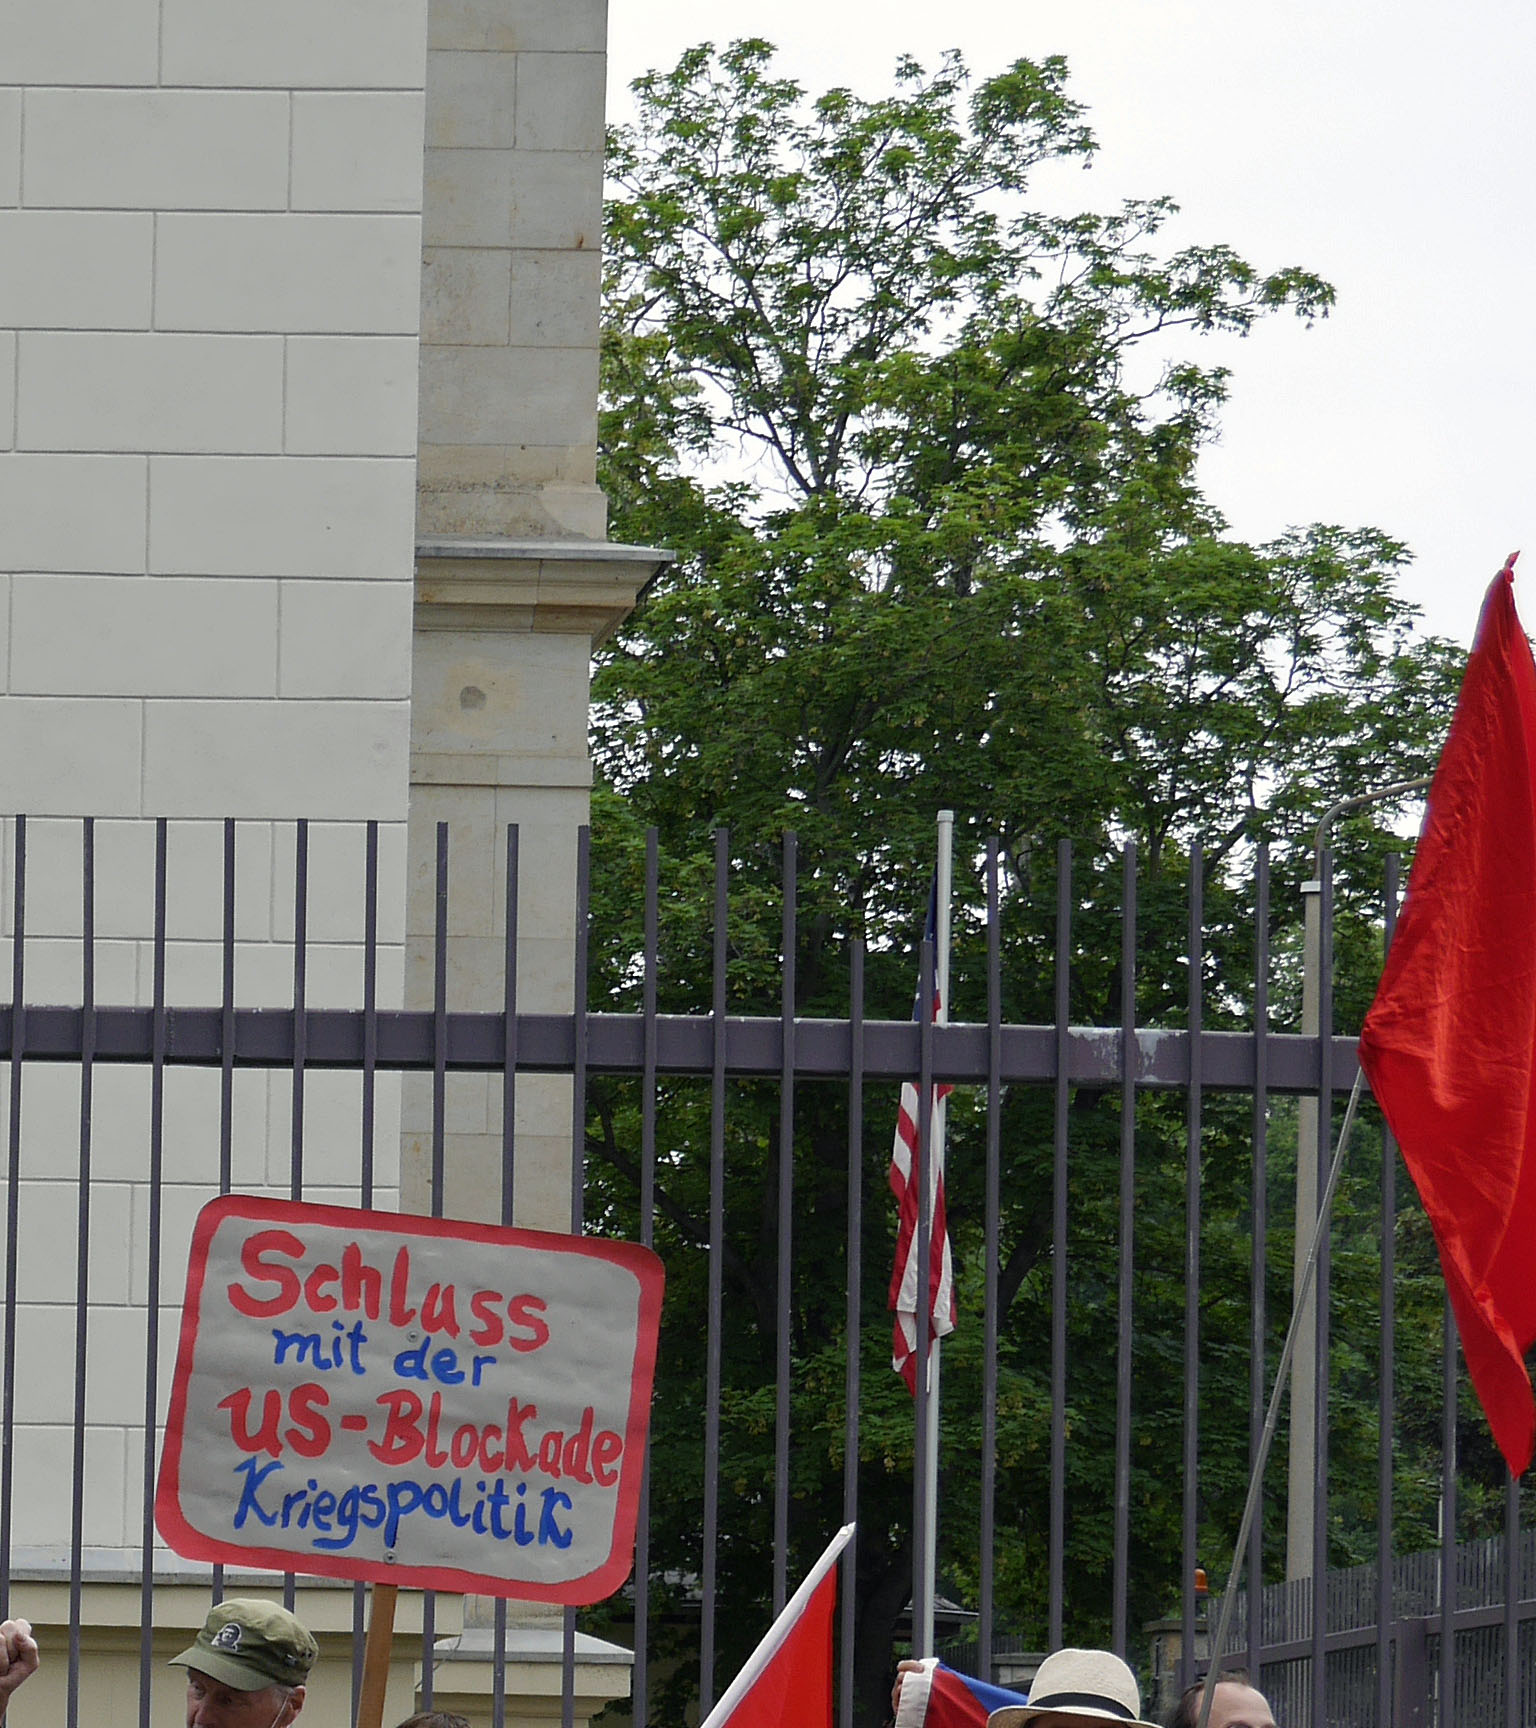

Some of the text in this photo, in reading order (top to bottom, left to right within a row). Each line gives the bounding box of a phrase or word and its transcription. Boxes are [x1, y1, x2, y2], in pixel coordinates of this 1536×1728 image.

[227, 1229, 550, 1353] Schluss
[271, 1319, 498, 1387] mit der
